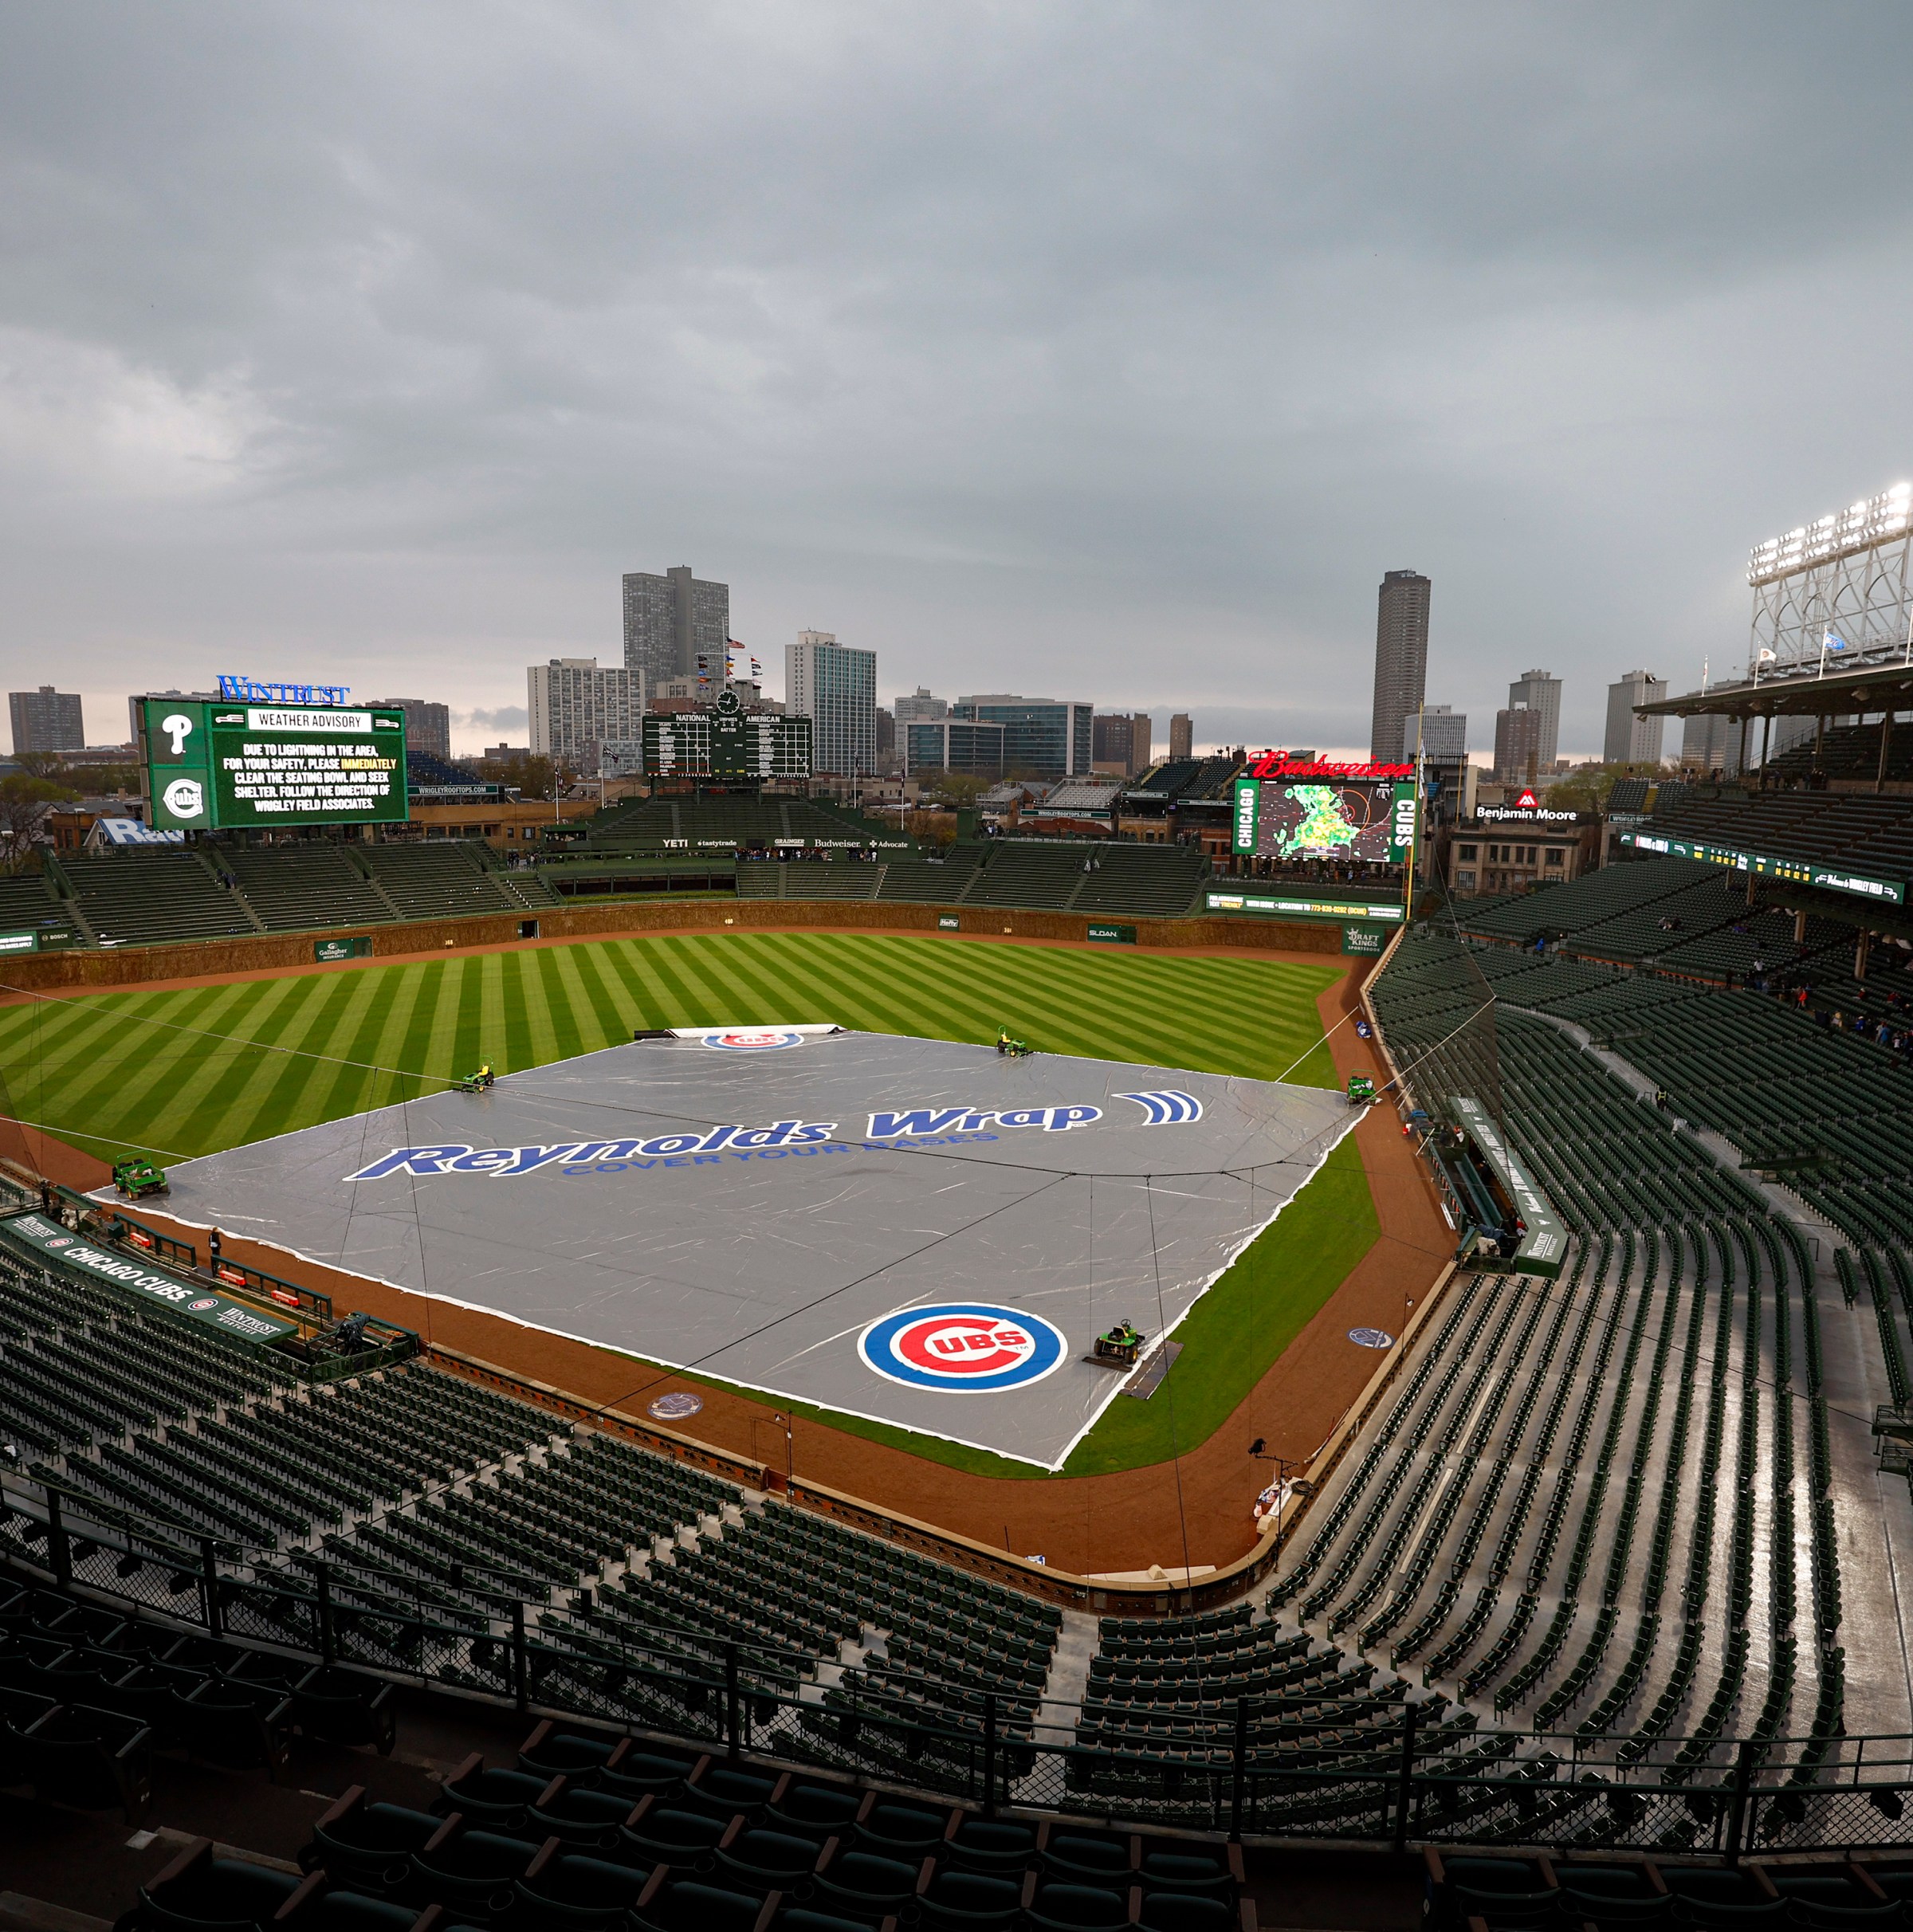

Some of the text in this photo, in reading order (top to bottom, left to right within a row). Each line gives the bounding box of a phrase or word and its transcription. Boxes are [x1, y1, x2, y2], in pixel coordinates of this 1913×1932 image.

[217, 675, 350, 705] WINTRUST
[259, 713, 361, 728] WEATHER ADVISORY
[243, 744, 379, 757] DUE TO LIGHTNING IN THE AREA,
[223, 758, 397, 771] FOR YOUR SAFETY, PLEASE IMMEDIATELY
[1248, 751, 1415, 778] Budweiser
[235, 772, 389, 783] CLEAR THE SEATING BOWL AND SEEK
[234, 785, 391, 798] SHELTER. FOLLOW THE DIRECTION OF
[254, 798, 375, 811] WRIGLEY FIELD ASSOCIATES.
[1477, 807, 1577, 820] Benjamin Moore
[1238, 788, 1255, 848] CHICAGO
[1395, 799, 1416, 847] CUBS
[343, 1105, 1103, 1182] Reynolds Wrap
[563, 1133, 999, 1176] COVER YOUR BASES
[1527, 1232, 1550, 1257] WINTRUST
[64, 1247, 194, 1302] CHICAGO CUBS
[217, 1317, 257, 1335] MORTGAGE
[223, 1308, 281, 1333] WINTRUST
[899, 1318, 1027, 1373] CUBS
